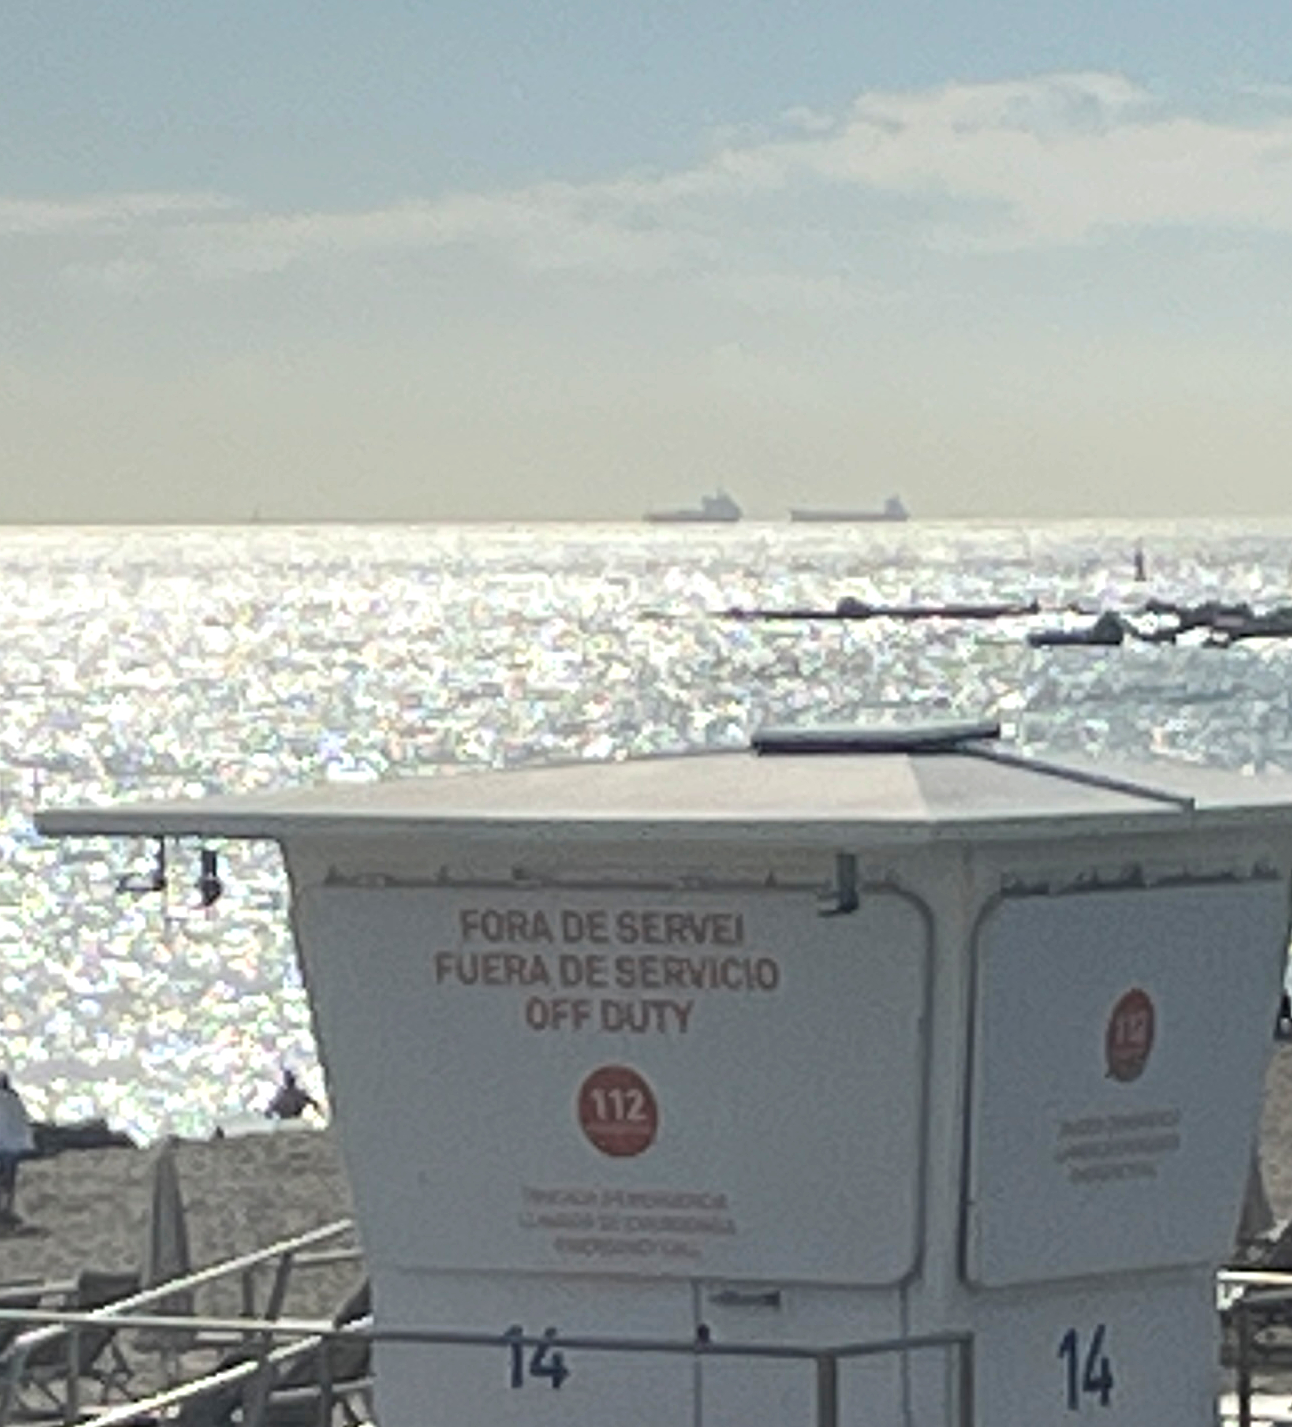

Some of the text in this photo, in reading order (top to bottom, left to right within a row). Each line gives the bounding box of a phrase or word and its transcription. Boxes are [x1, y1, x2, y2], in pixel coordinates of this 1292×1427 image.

[459, 910, 745, 946] FORA DE SERVEI
[436, 953, 780, 990] FUERA DE SERVICIO
[525, 999, 694, 1034] OFF DUTY
[589, 1087, 648, 1121] 112
[500, 1325, 569, 1389] 14
[1057, 1324, 1114, 1410] 14
